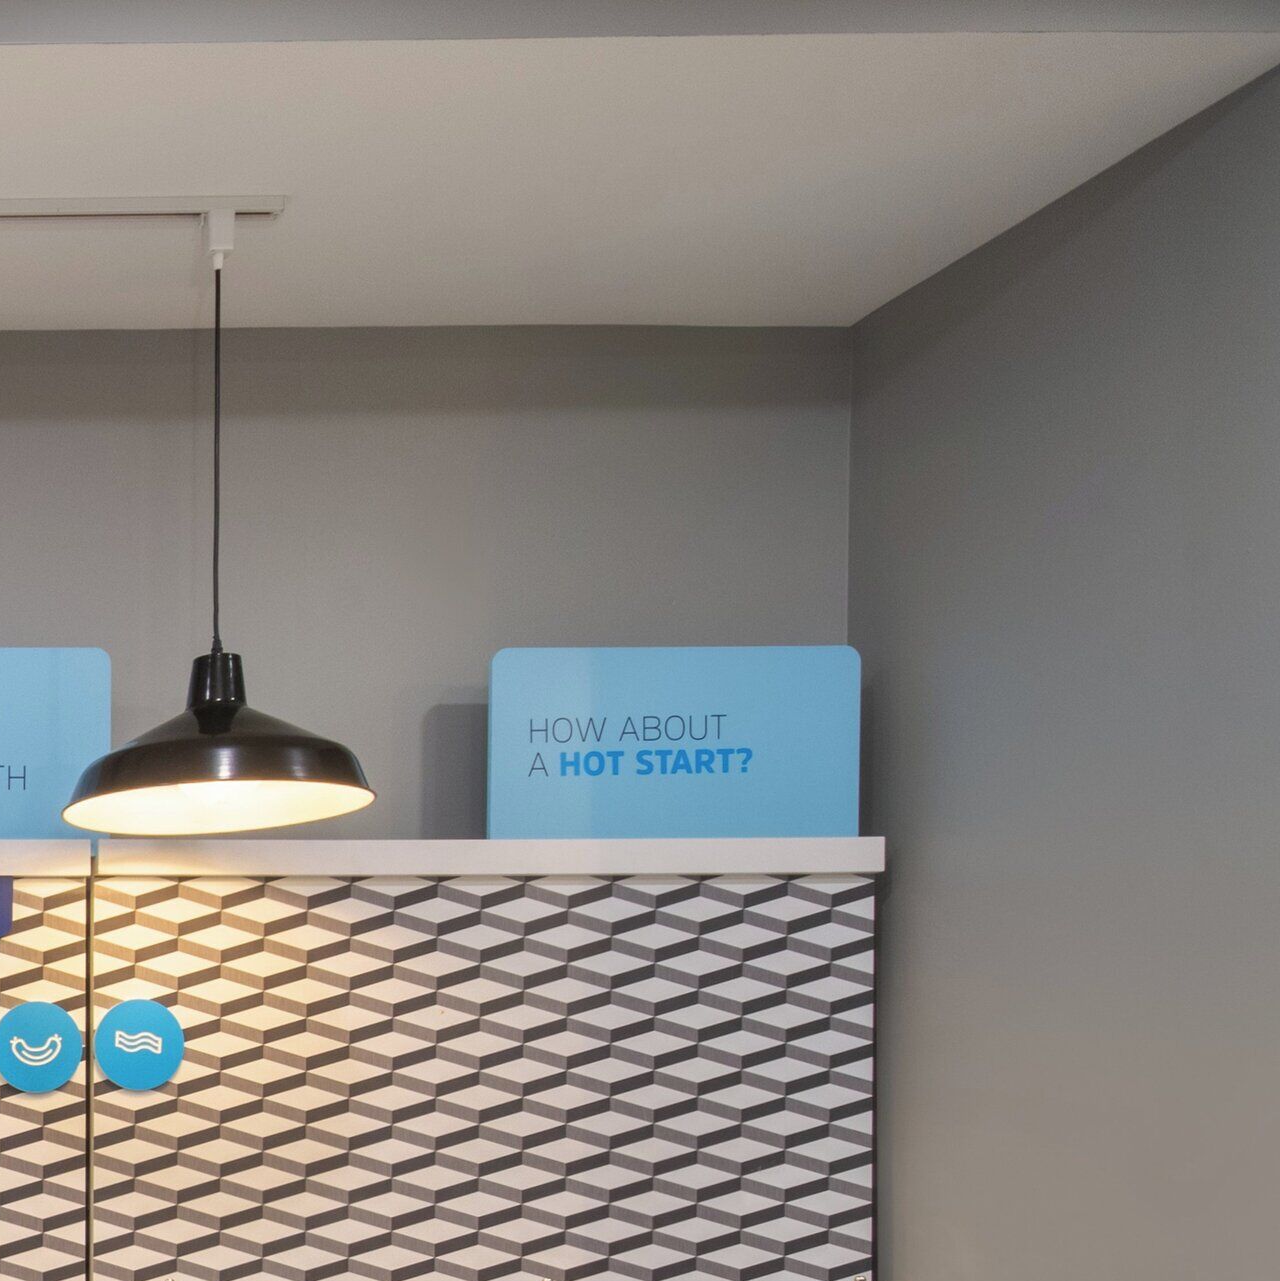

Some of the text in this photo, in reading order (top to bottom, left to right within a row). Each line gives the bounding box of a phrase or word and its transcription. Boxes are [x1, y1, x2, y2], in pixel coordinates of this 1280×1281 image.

[529, 714, 727, 744] HOW ABOUT
[528, 747, 754, 777] A HOT START?
